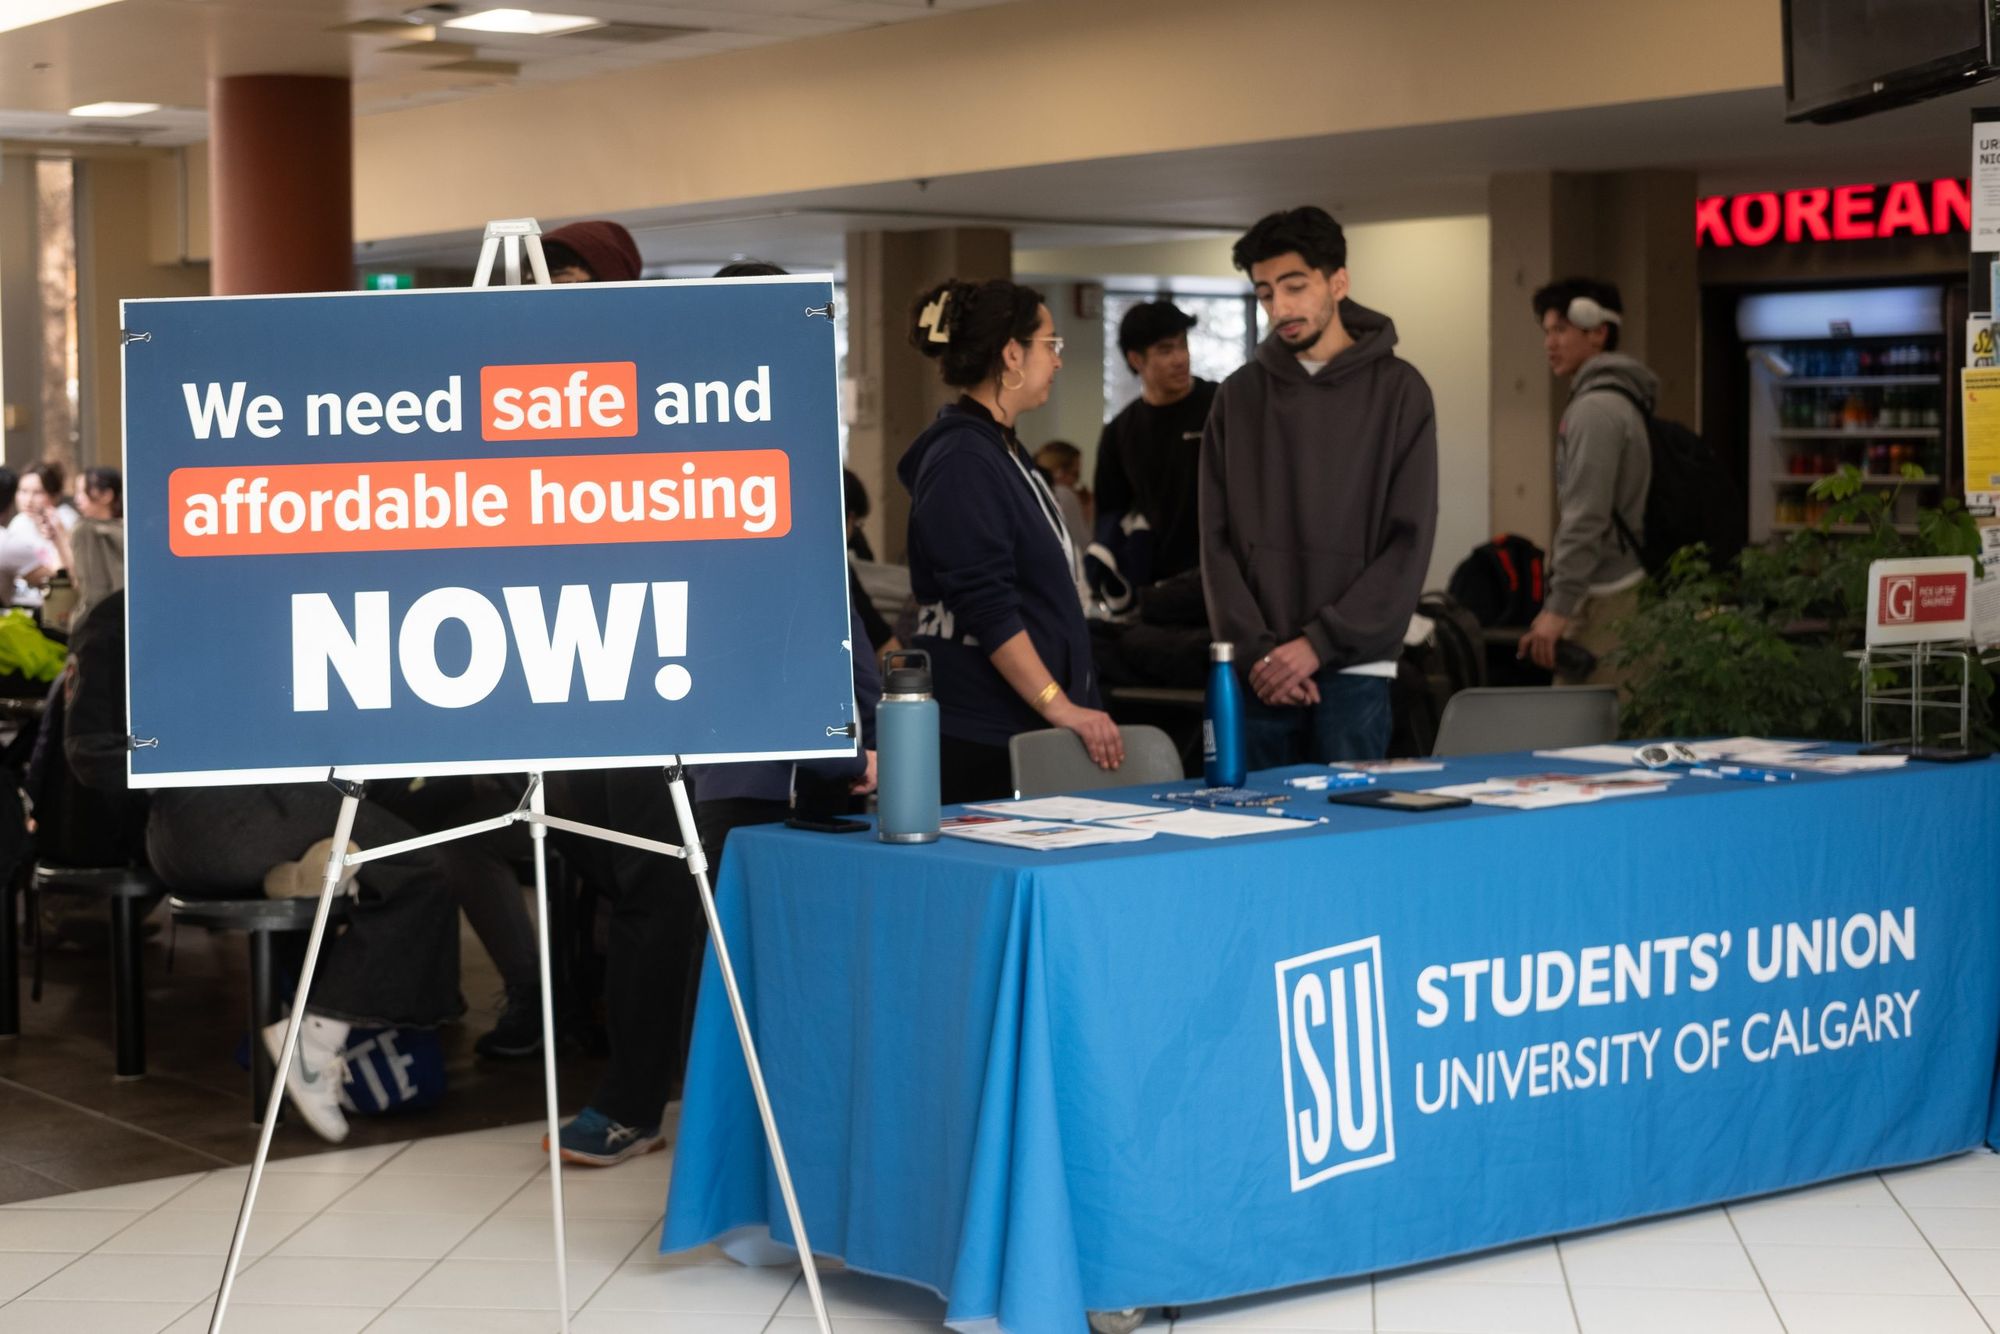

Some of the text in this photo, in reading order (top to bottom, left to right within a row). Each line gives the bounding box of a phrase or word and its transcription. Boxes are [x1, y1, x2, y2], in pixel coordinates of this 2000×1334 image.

[1695, 177, 1971, 247] KOREAN
[182, 366, 772, 440] We need safe and
[183, 462, 777, 537] affordable housing
[291, 581, 693, 712] NOW!
[1887, 579, 1913, 621] G
[1416, 906, 1916, 1028] STUDENTS’ UNION
[1292, 958, 1379, 1166] SU
[1415, 989, 1921, 1115] UNIVERSITY OF CALGARY
